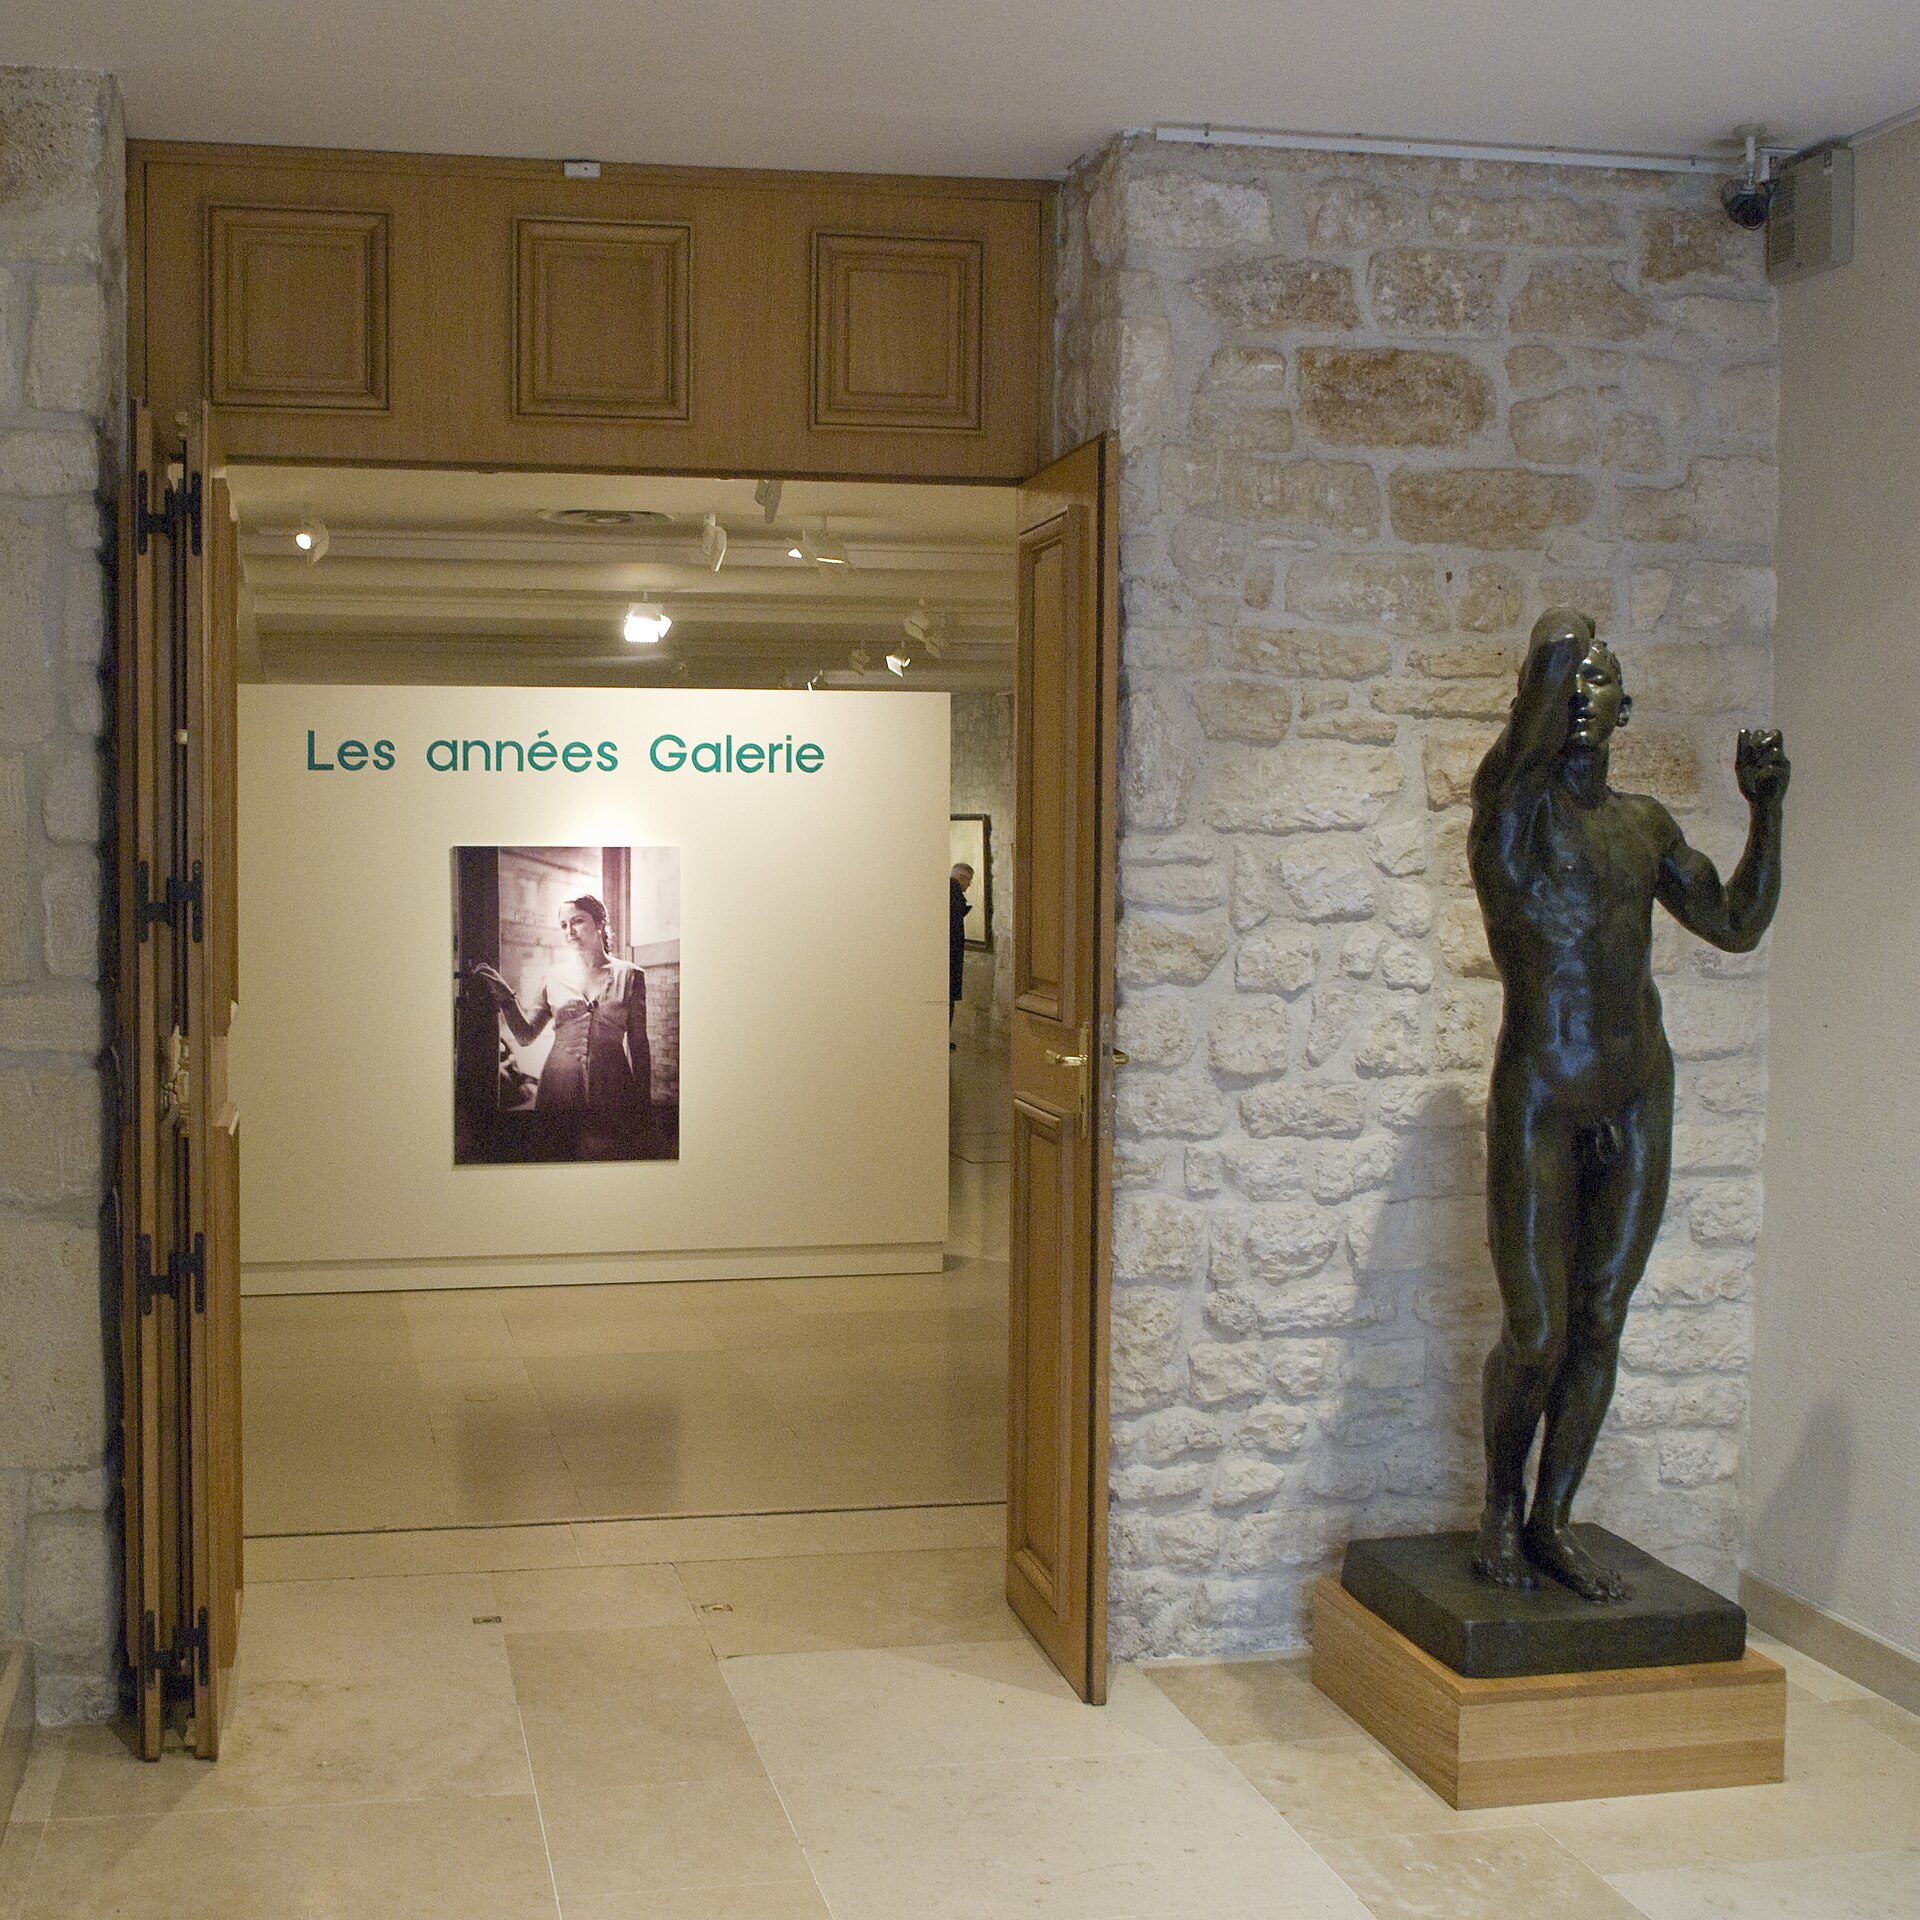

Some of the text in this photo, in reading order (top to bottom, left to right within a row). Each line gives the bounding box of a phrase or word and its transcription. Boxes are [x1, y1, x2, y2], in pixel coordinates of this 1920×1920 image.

[307, 730, 825, 774] Les années Galerie
